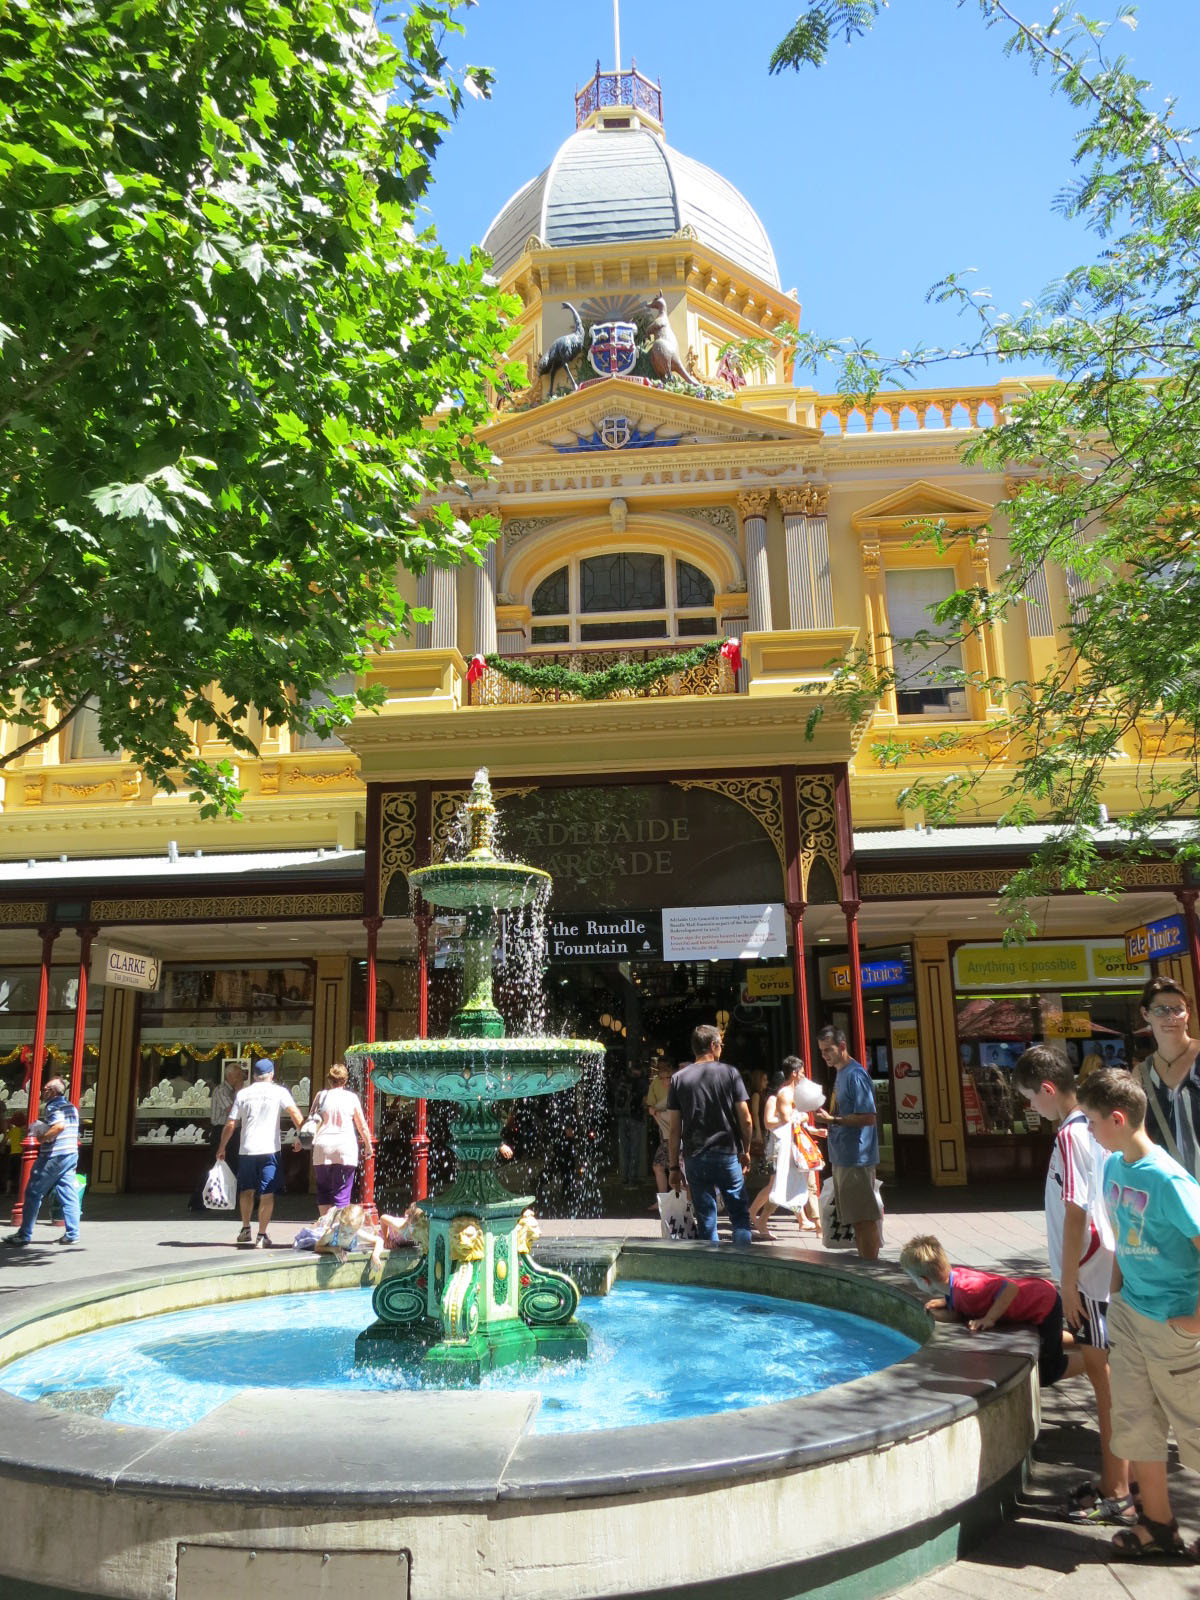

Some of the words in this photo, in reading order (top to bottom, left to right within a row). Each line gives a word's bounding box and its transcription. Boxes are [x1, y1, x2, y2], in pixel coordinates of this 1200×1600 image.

[496, 474, 624, 494] ADELAIDE
[641, 467, 742, 485] ARCADE
[524, 817, 690, 847] ADELAIDE
[549, 850, 674, 878] ARCADE
[552, 922, 579, 936] the
[586, 919, 646, 936] Rundle
[513, 941, 550, 956] Ml
[554, 940, 628, 956] Fountain
[1128, 924, 1181, 957] TeleChoice
[110, 953, 146, 975] CLARKE
[968, 960, 1016, 975] Anything
[1020, 961, 1029, 971] is
[1032, 957, 1077, 973] possible
[1105, 962, 1138, 971] OPTUS
[760, 981, 790, 990] OPTUS
[831, 964, 902, 987] TelChoice
[897, 1110, 924, 1120] boost
